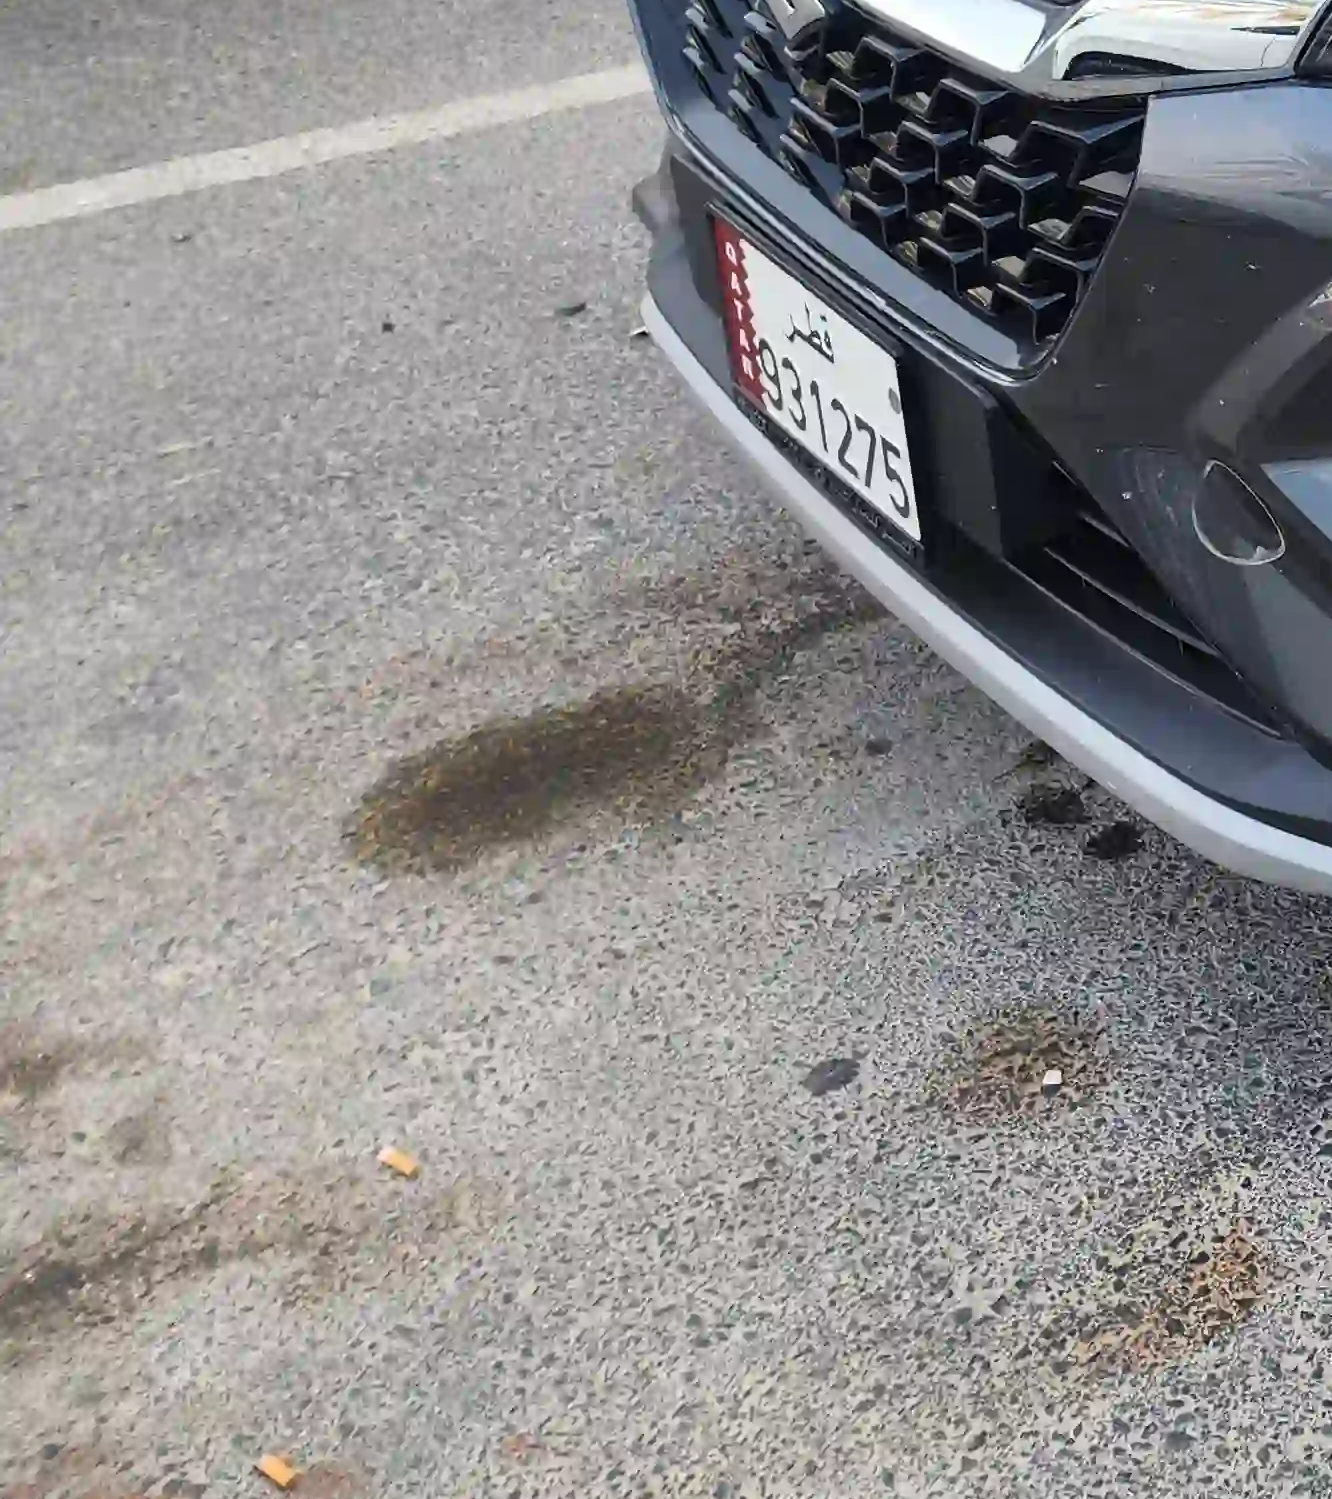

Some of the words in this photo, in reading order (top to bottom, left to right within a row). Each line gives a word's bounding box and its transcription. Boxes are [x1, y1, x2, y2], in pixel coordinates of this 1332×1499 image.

[724, 240, 755, 382] QATAR
[785, 301, 835, 364] قطر
[758, 338, 911, 519] 931275
